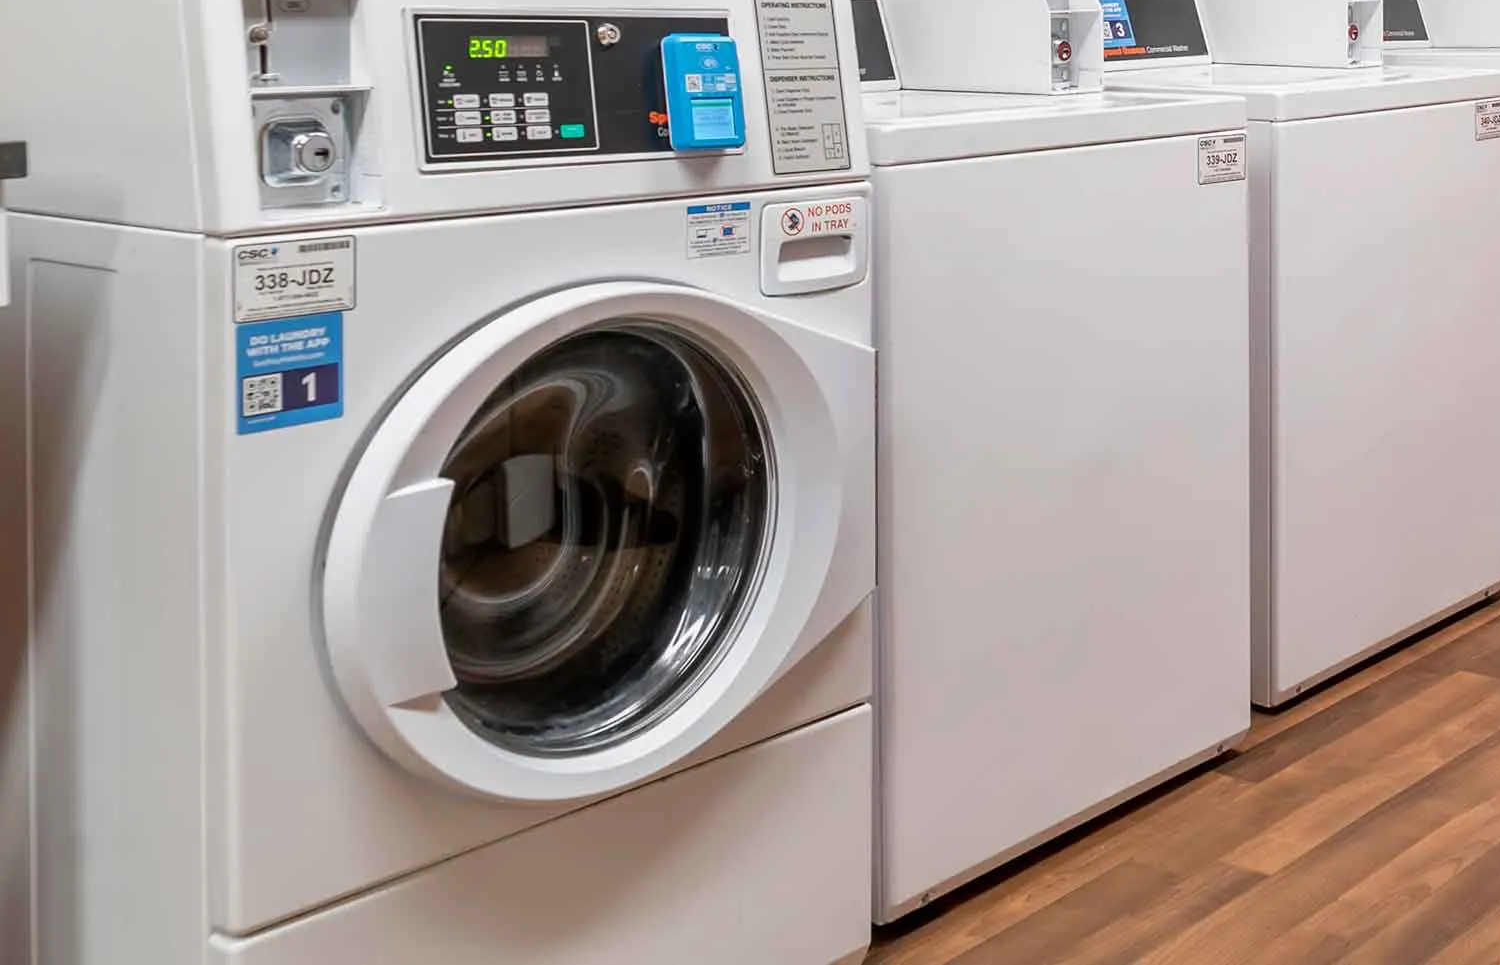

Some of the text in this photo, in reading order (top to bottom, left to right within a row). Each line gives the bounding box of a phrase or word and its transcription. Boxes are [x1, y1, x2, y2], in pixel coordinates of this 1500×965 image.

[1115, 22, 1126, 37] 3
[469, 39, 508, 59] 2.50
[1206, 152, 1238, 166] 339-JDZ
[706, 204, 732, 212] NOTICE
[808, 203, 852, 218] NO PODS
[811, 218, 849, 233] IN TRAY
[238, 248, 269, 260] CSC
[255, 267, 335, 291] 338-JDZ
[249, 326, 327, 347] DO LAUNDRY
[245, 336, 331, 357] WITH THE APP
[302, 371, 317, 402] 1
